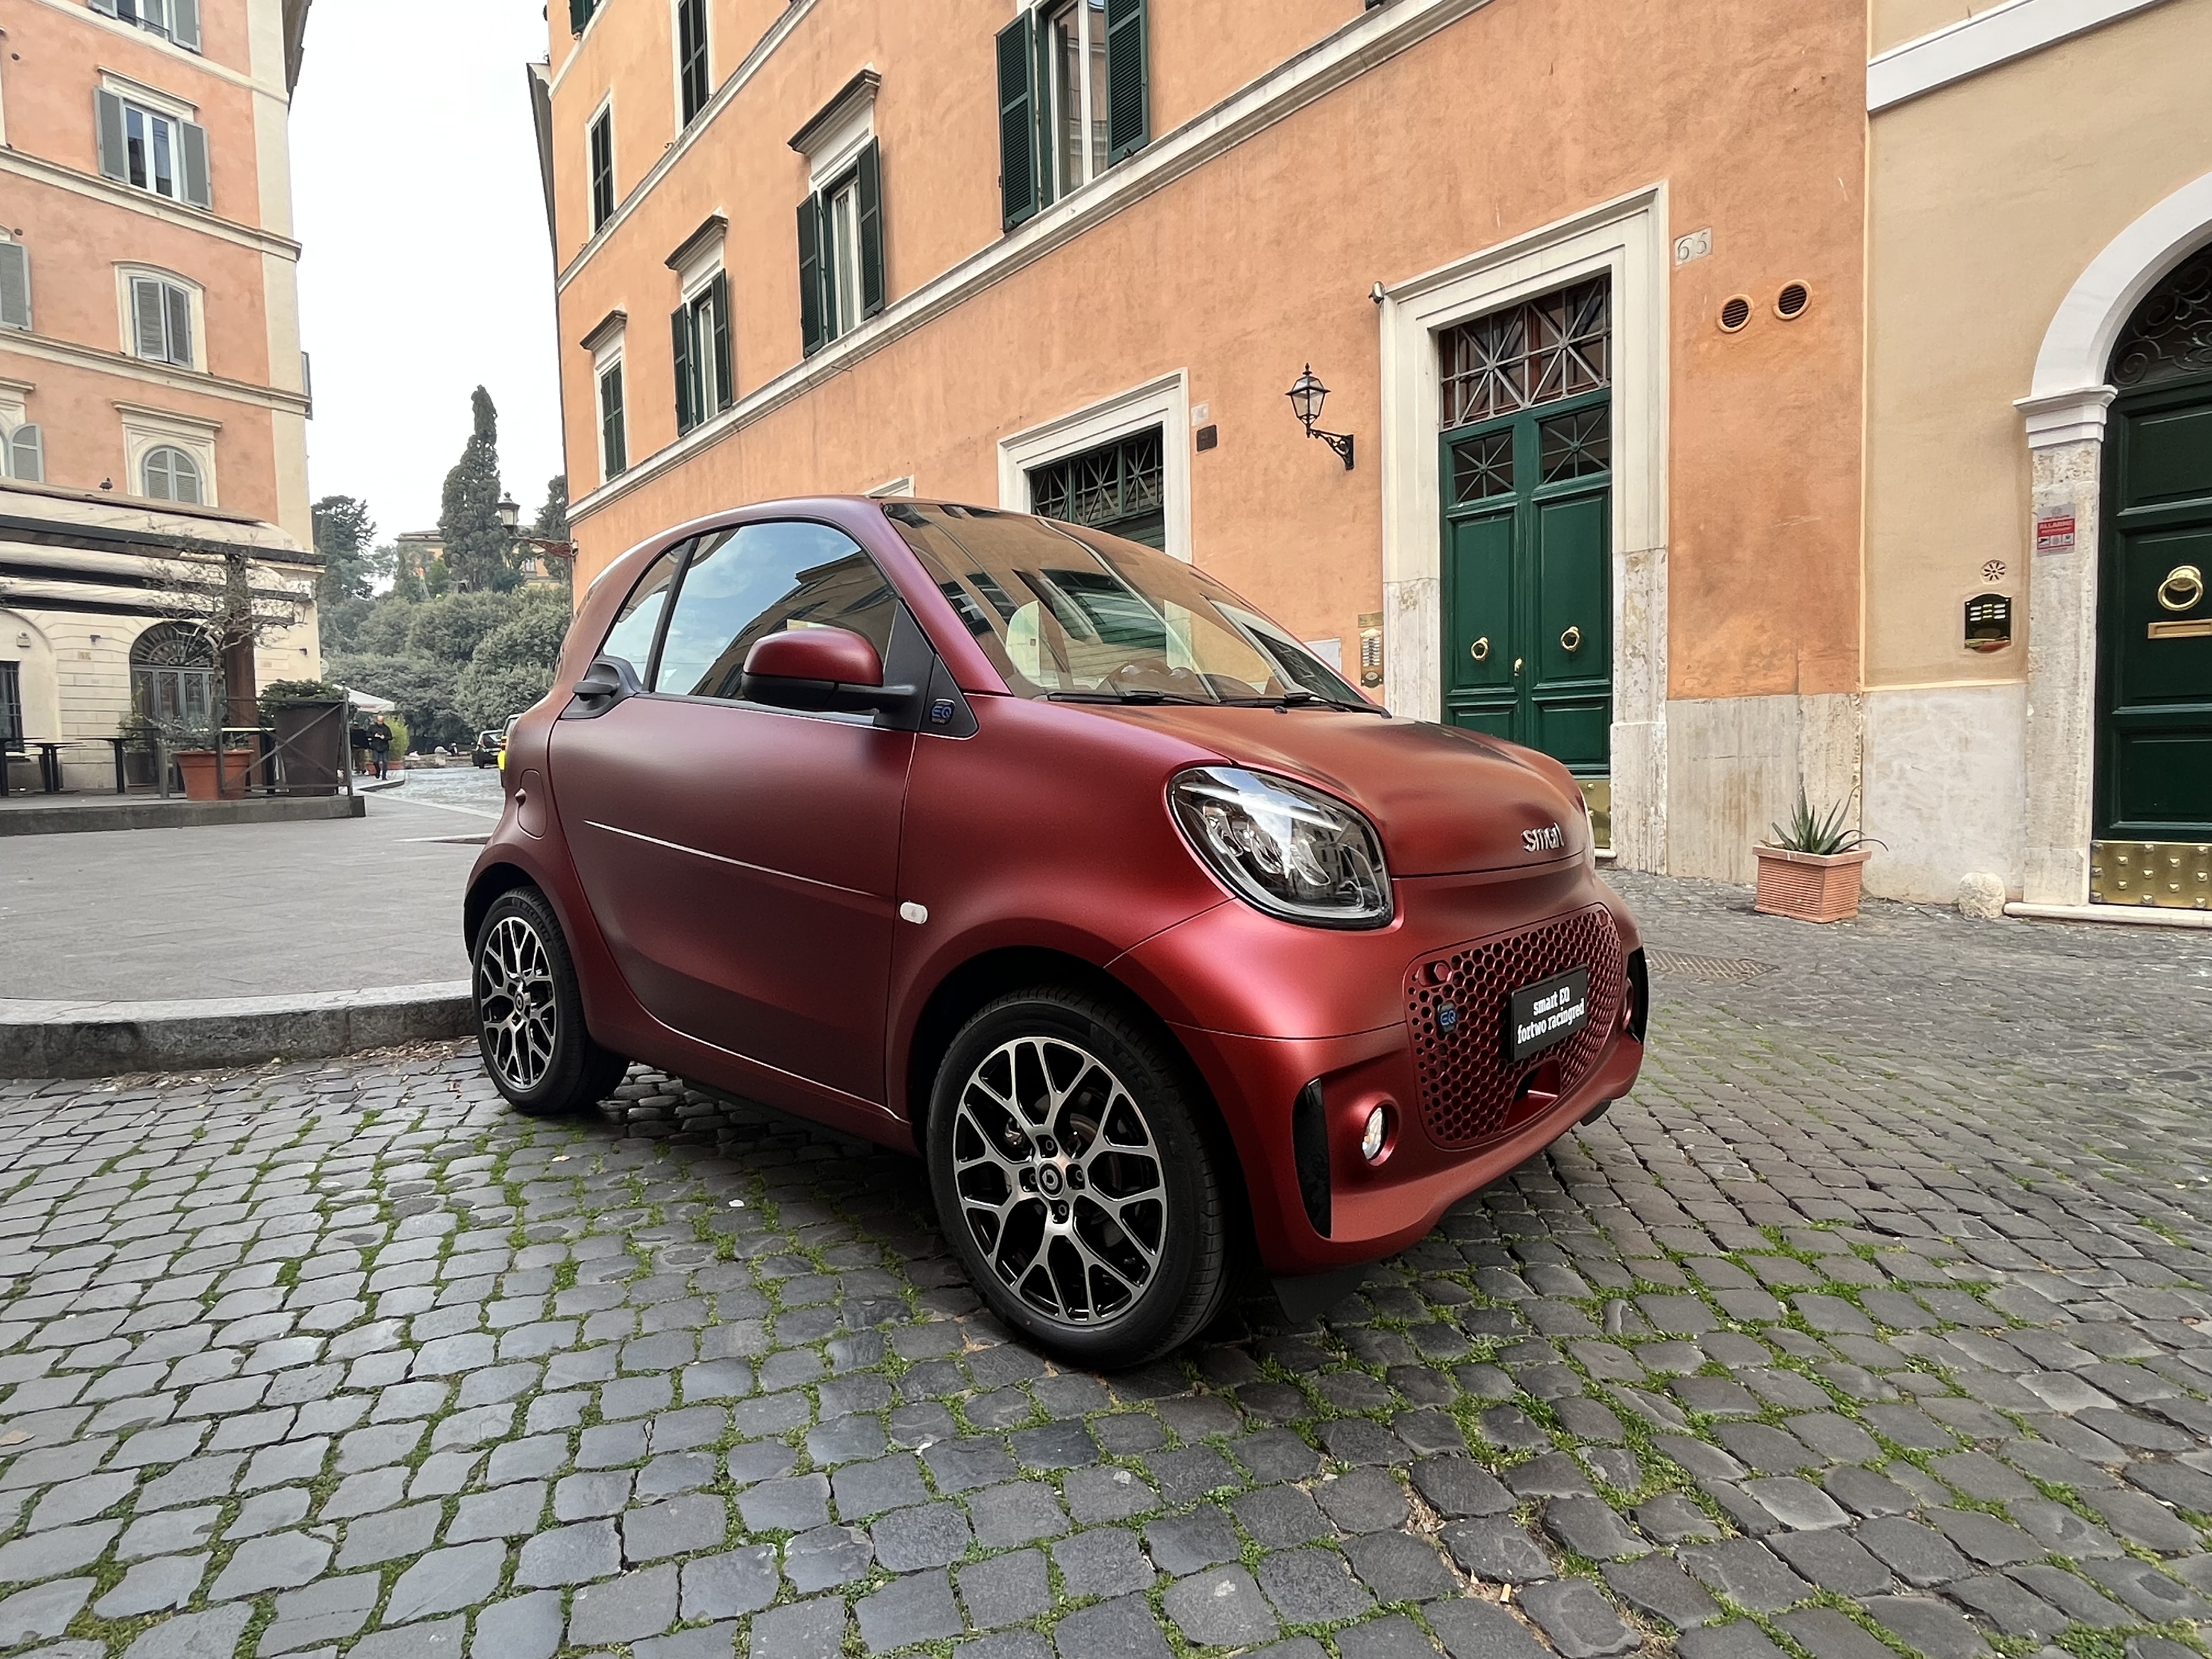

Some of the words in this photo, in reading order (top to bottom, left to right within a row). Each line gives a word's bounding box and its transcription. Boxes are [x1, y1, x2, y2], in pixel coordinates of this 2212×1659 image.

[932, 706, 951, 719] EQ
[1521, 822, 1565, 851] smart
[1533, 991, 1558, 1016] smart
[1559, 986, 1570, 1005] EQ
[1440, 1010, 1456, 1026] EQ
[1517, 1019, 1547, 1044] fortwo
[1548, 997, 1584, 1030] racingred
